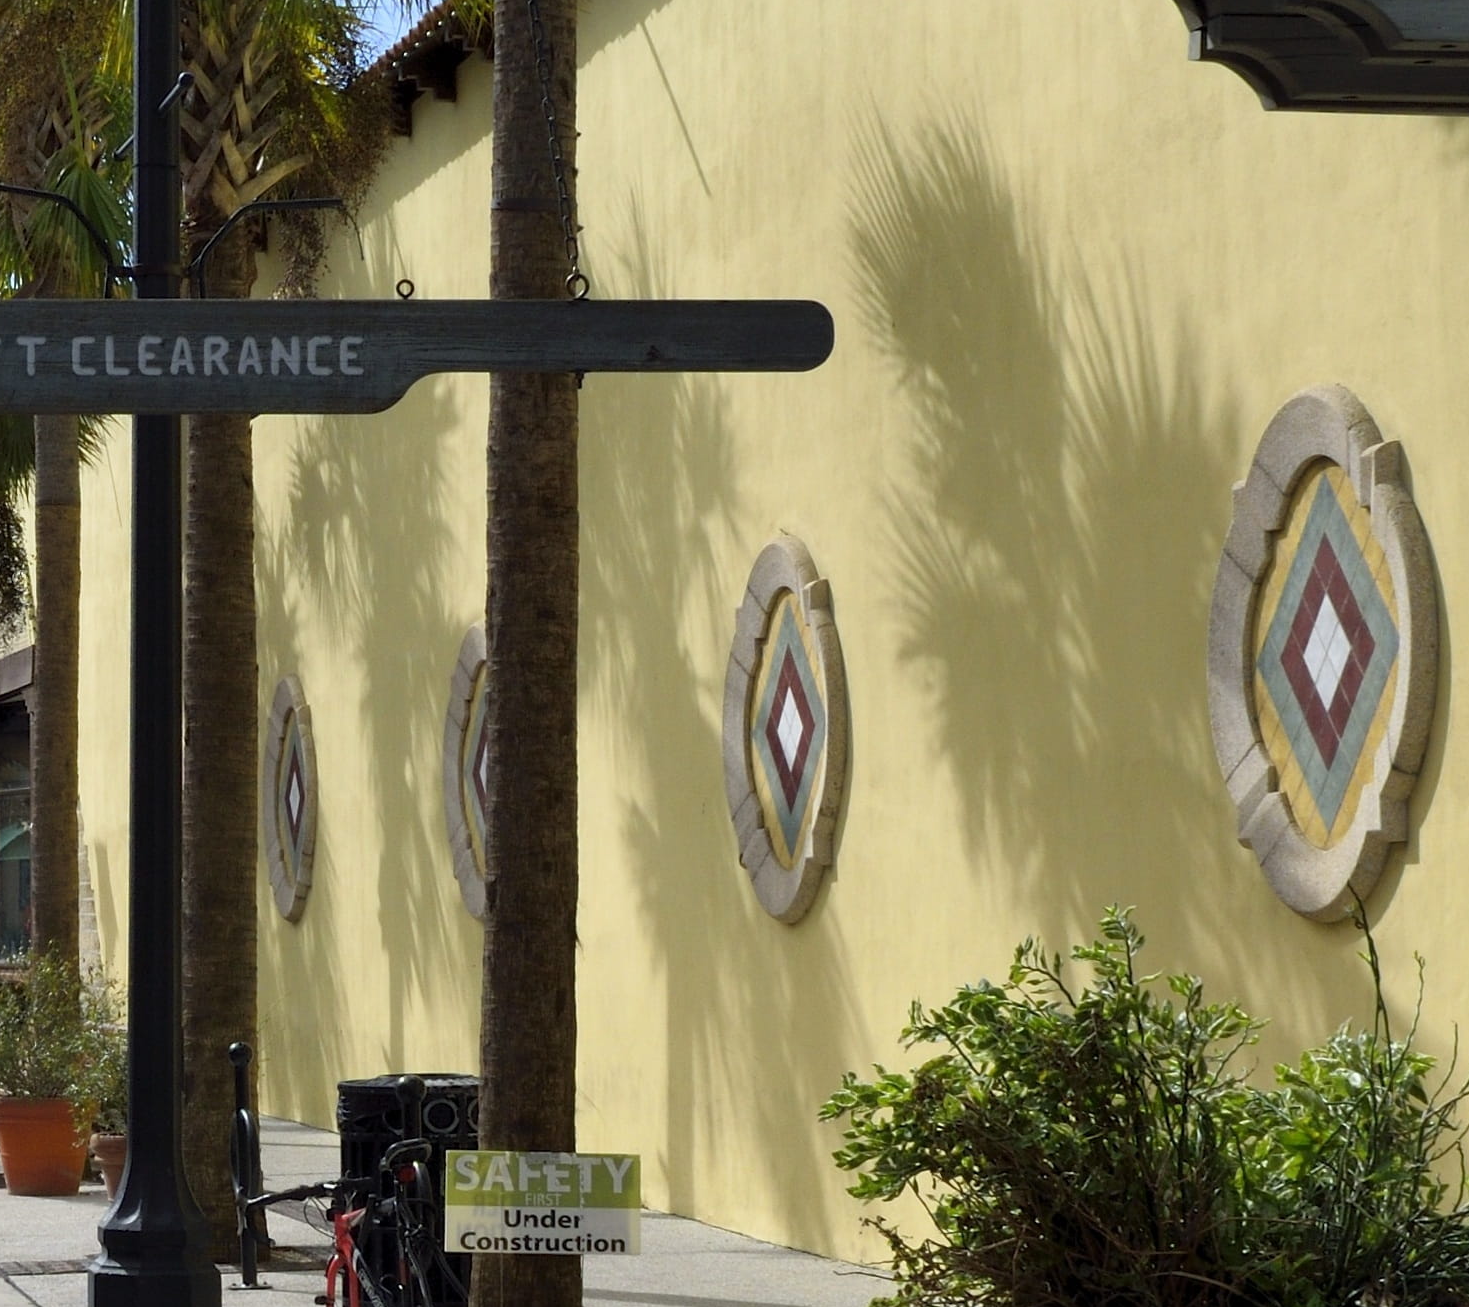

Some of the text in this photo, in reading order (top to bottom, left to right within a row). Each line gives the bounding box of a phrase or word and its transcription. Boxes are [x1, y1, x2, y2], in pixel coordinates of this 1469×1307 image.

[70, 335, 366, 377] CLEARANCE
[454, 1153, 634, 1195] SAFETY
[524, 1193, 562, 1207] FIRST
[502, 1209, 584, 1229] Under
[459, 1231, 626, 1254] Construction
